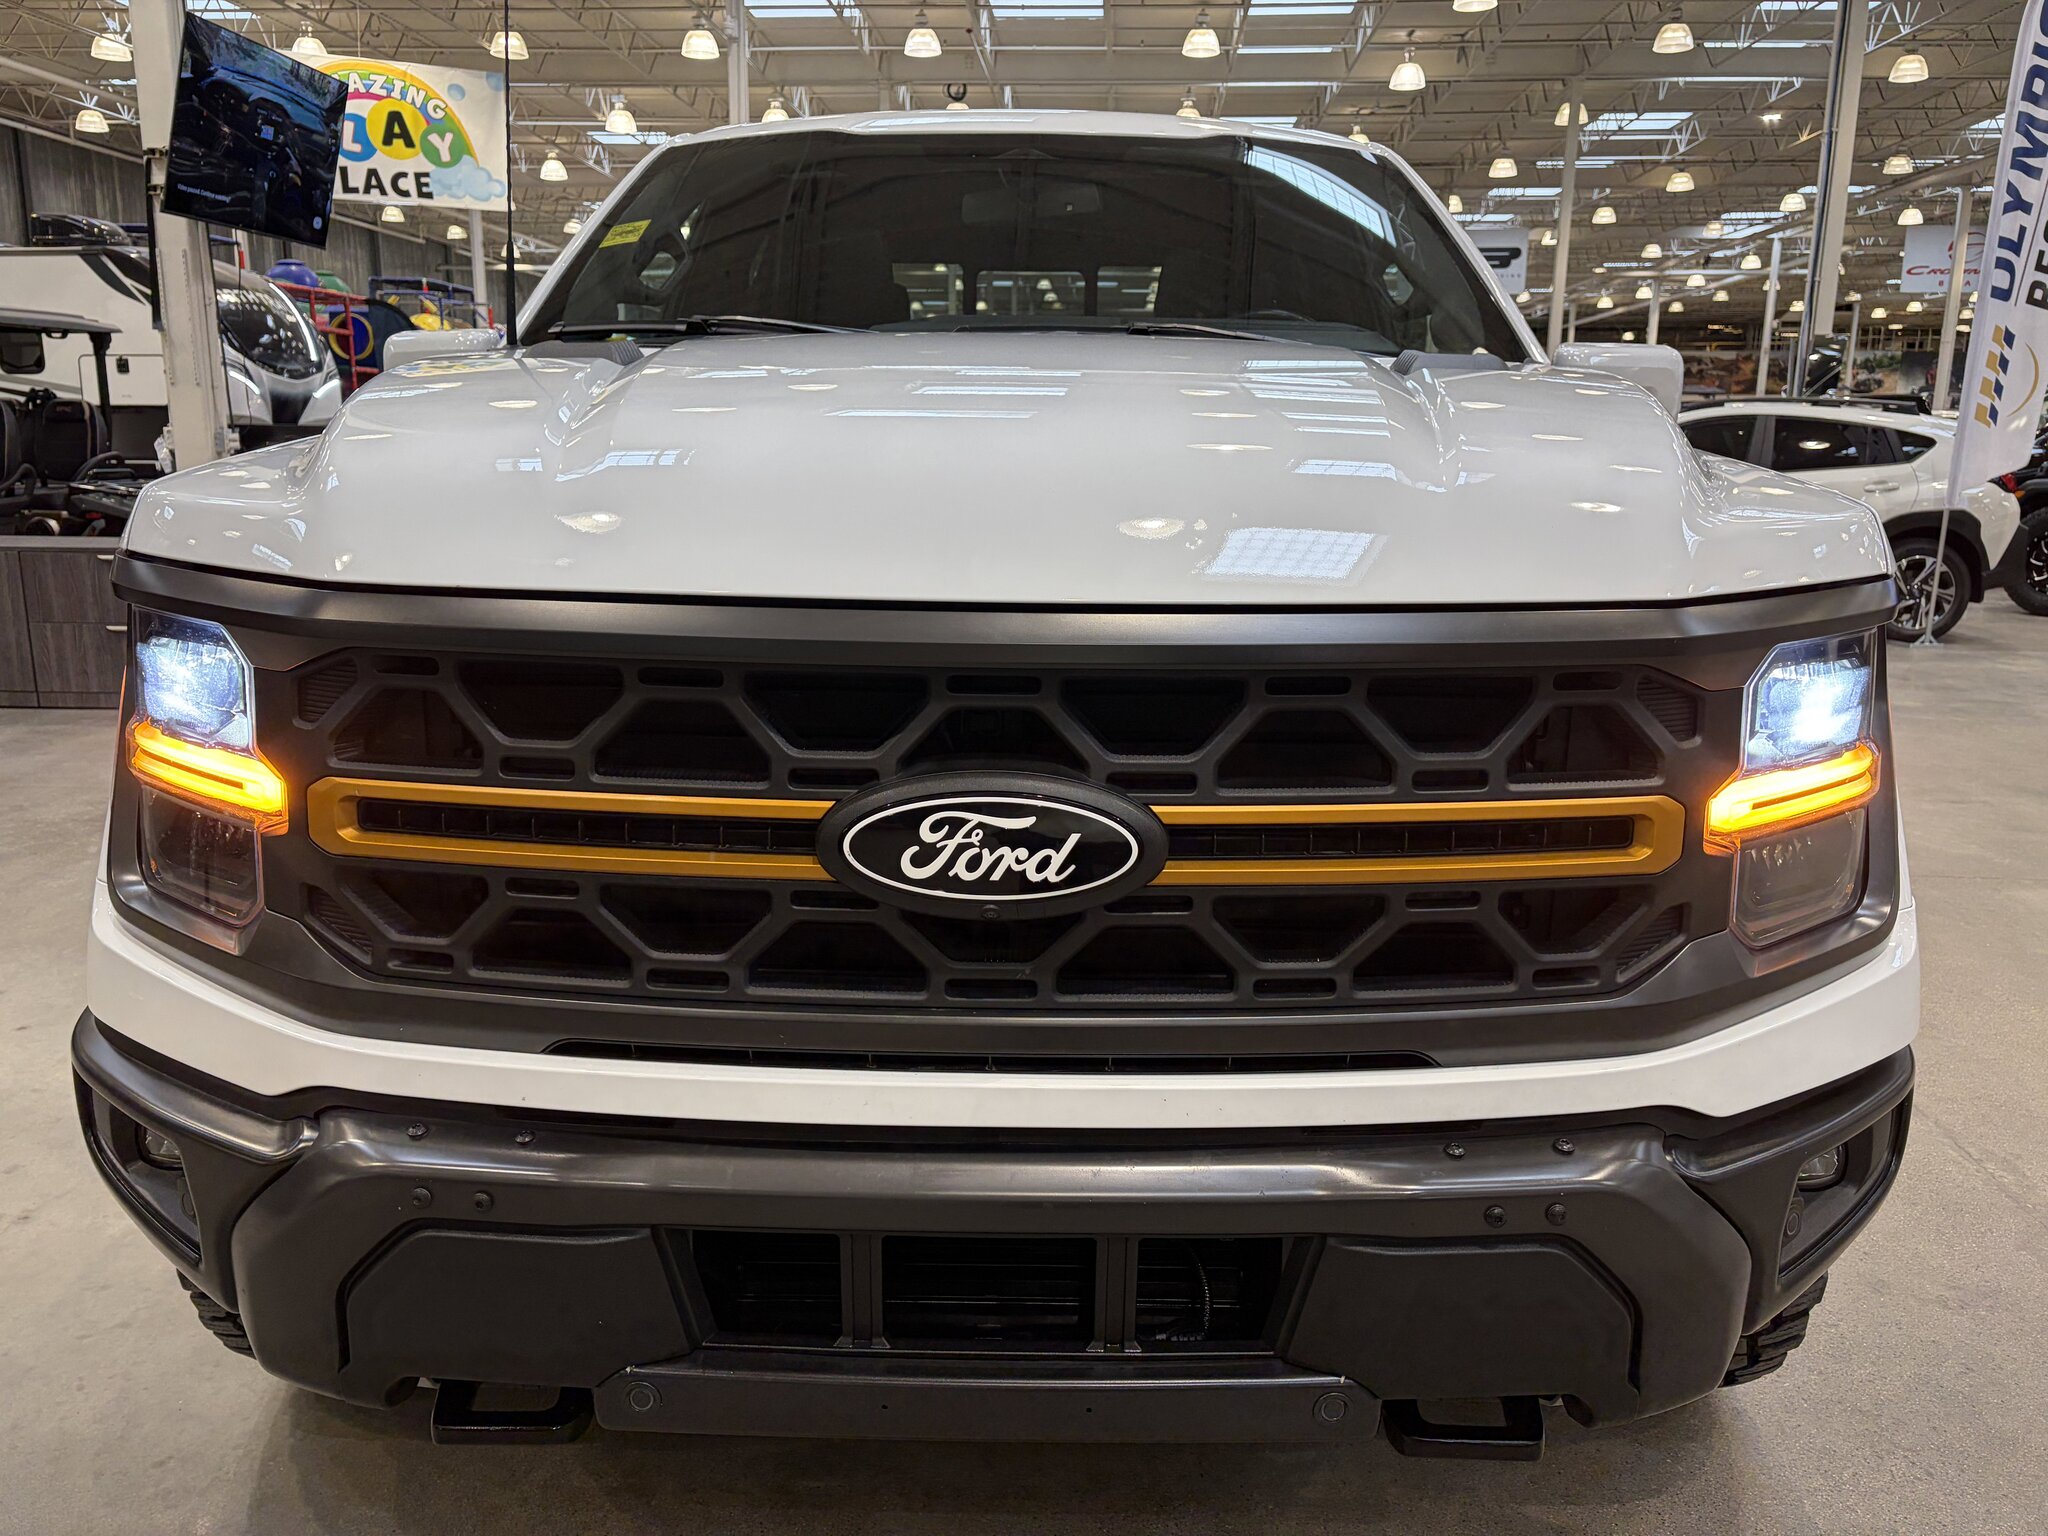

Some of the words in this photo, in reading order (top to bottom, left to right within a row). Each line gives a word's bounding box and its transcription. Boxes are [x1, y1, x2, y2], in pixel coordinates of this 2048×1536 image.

[332, 72, 448, 120] AZING
[342, 110, 454, 163] LAY
[1990, 0, 2048, 302] OLYMPI
[338, 166, 434, 199] LACE
[901, 811, 1081, 883] Ford
